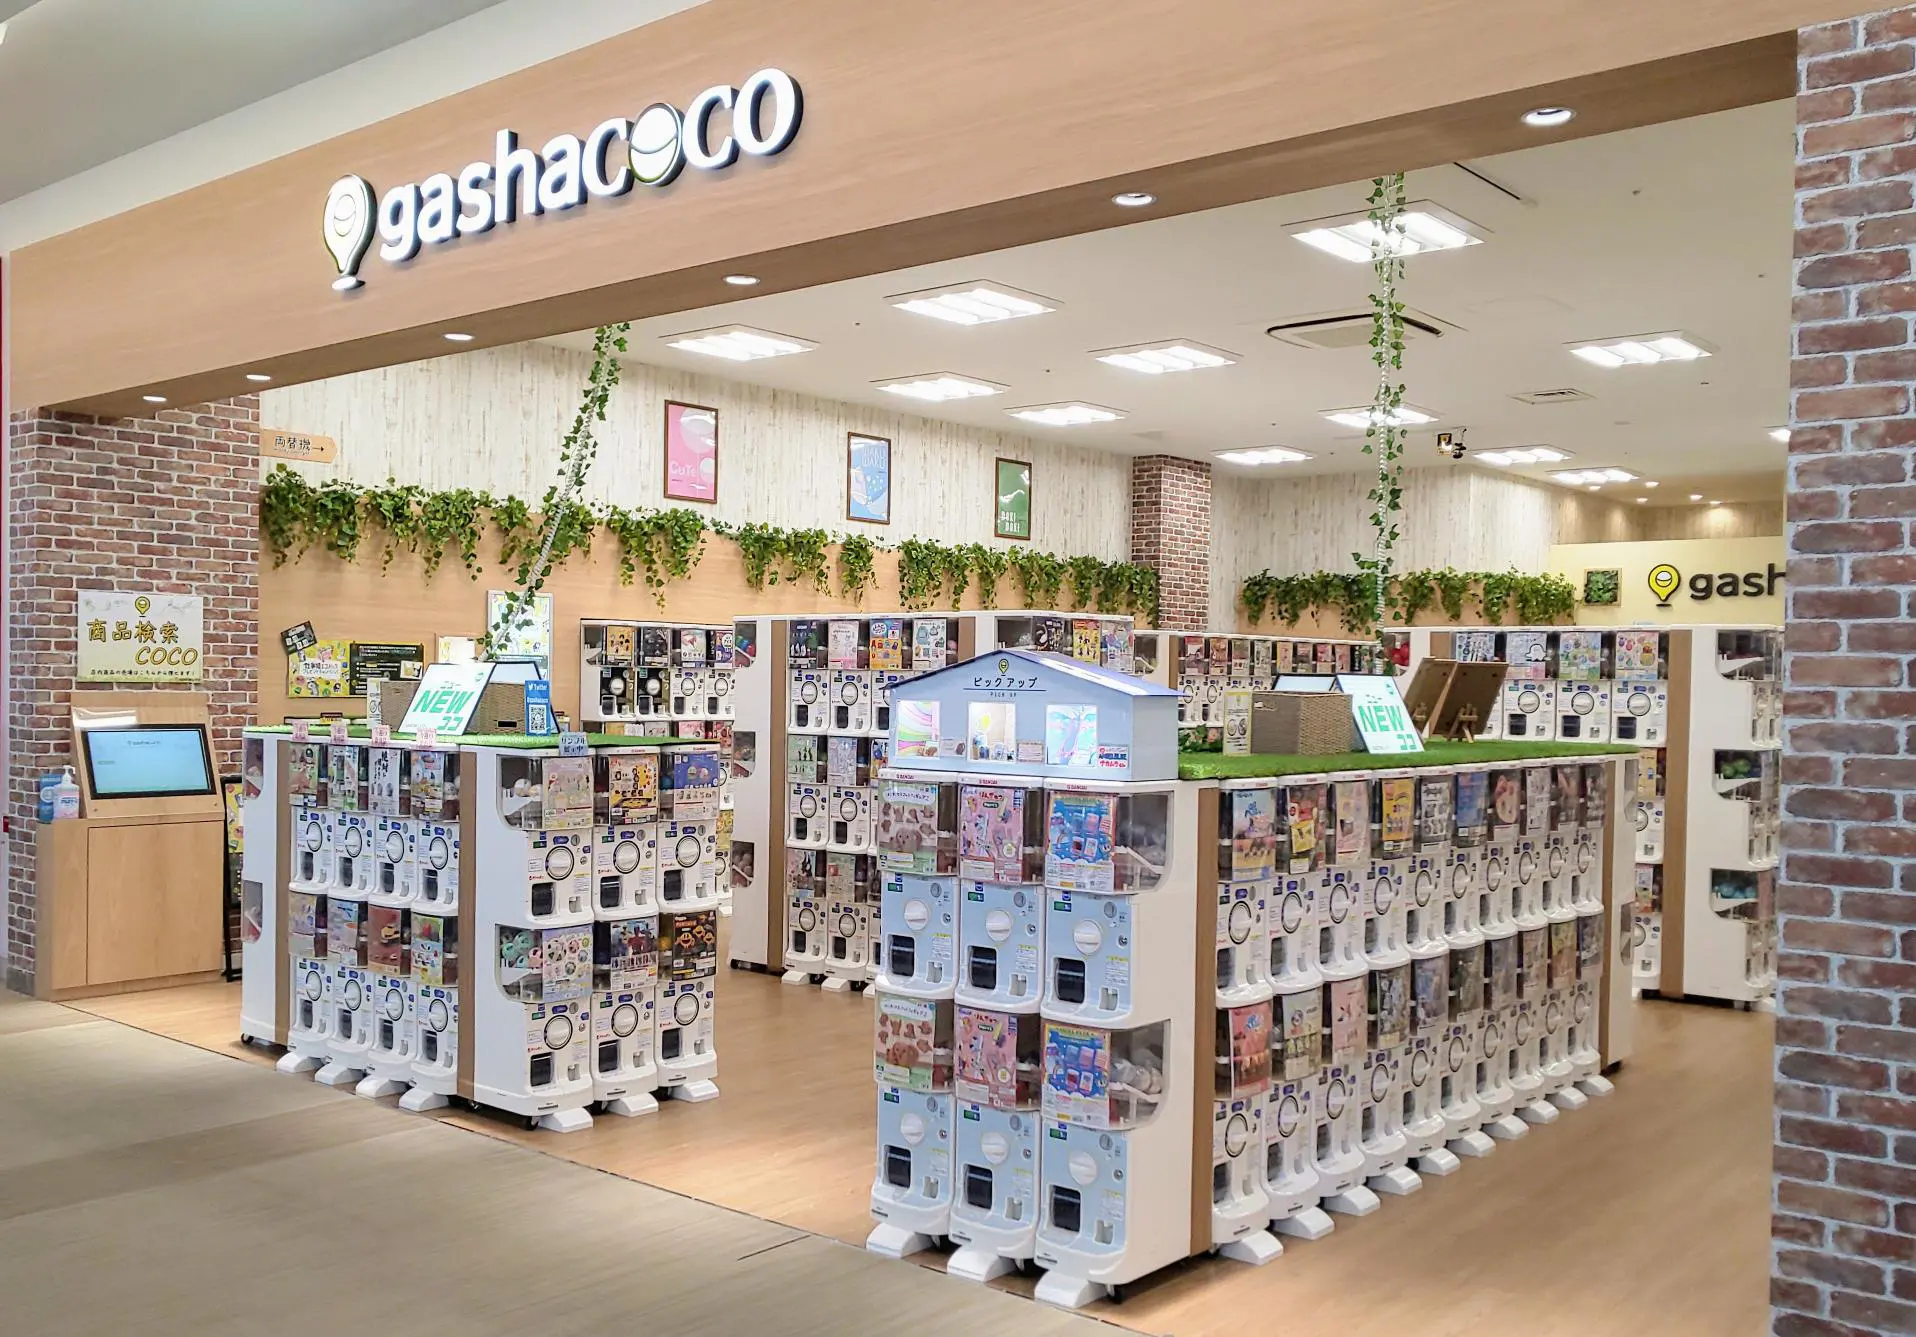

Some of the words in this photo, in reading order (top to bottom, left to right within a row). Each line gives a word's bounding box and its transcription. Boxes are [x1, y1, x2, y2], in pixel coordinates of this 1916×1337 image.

[378, 67, 804, 262] gashacoco
[86, 618, 179, 644] 商品検索
[135, 646, 198, 666] COCO
[974, 677, 1037, 688] ピックアップ
[412, 690, 475, 713] NEW
[1358, 705, 1404, 732] NEW
